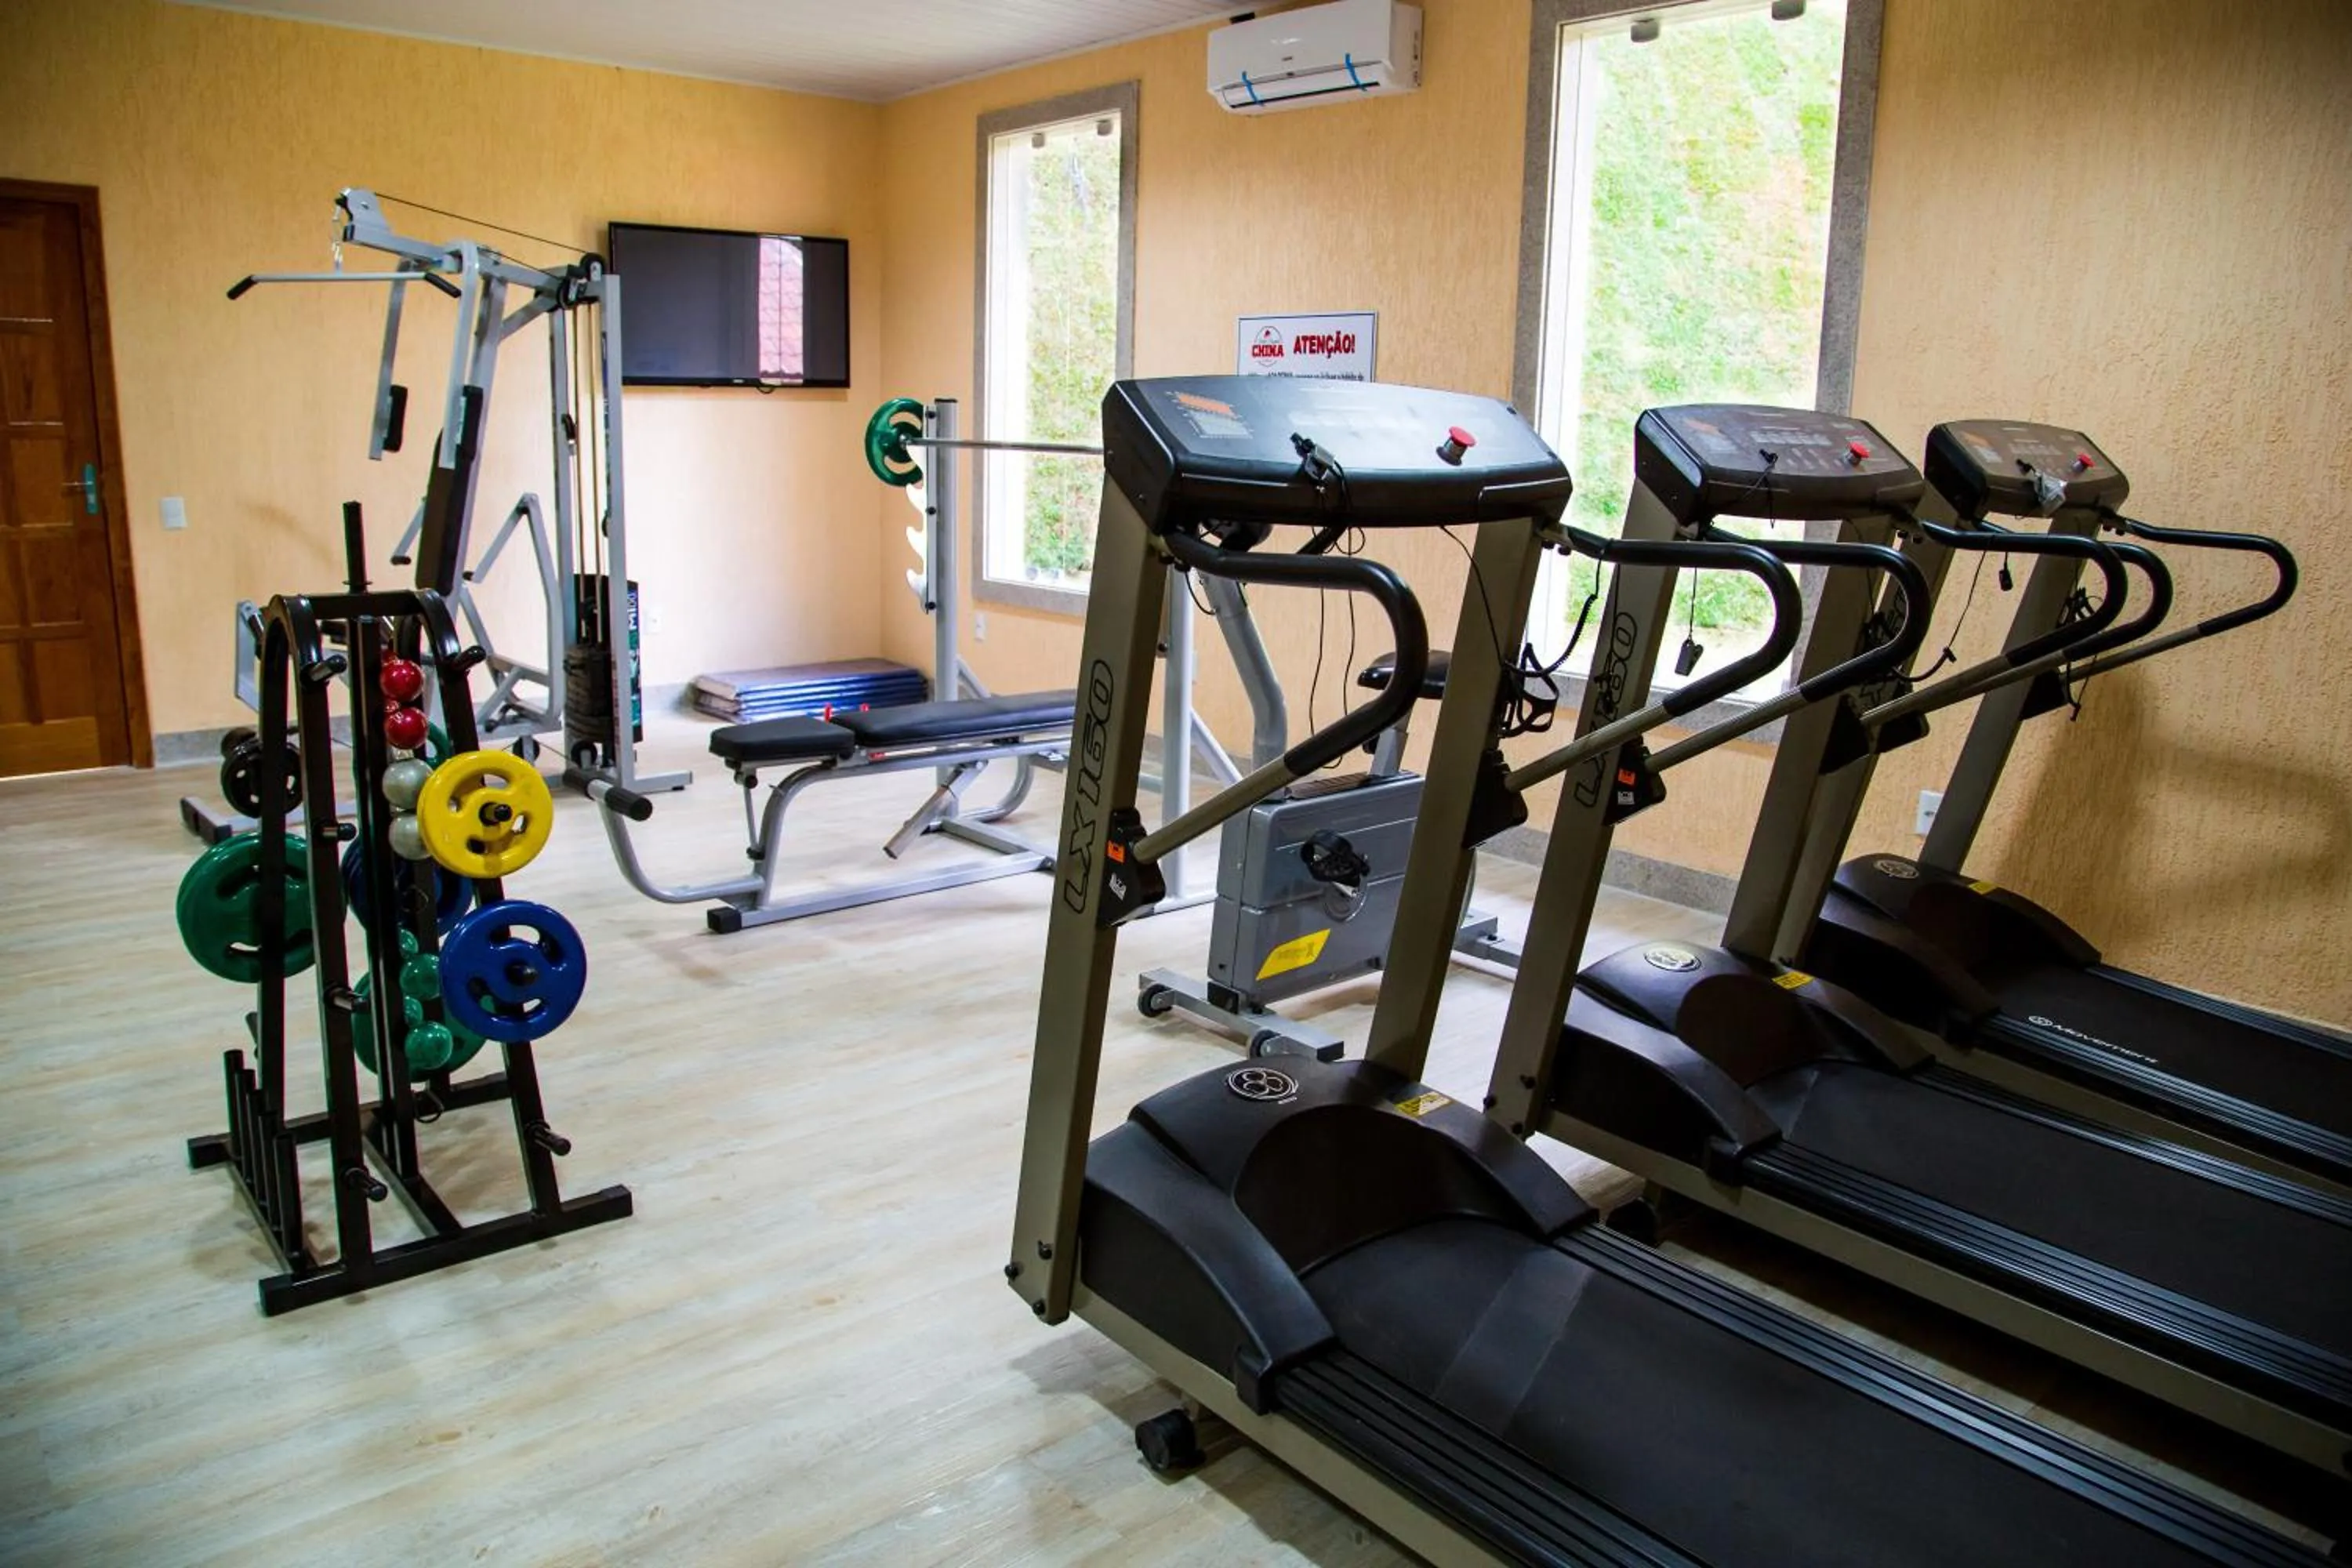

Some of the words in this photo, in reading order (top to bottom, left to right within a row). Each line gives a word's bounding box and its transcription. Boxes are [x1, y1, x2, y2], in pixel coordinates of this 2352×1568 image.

[1252, 344, 1284, 358] CHINA
[1293, 330, 1356, 359] ATENÇÃO!
[1573, 612, 1638, 808] L160
[1064, 659, 1114, 915] LX160
